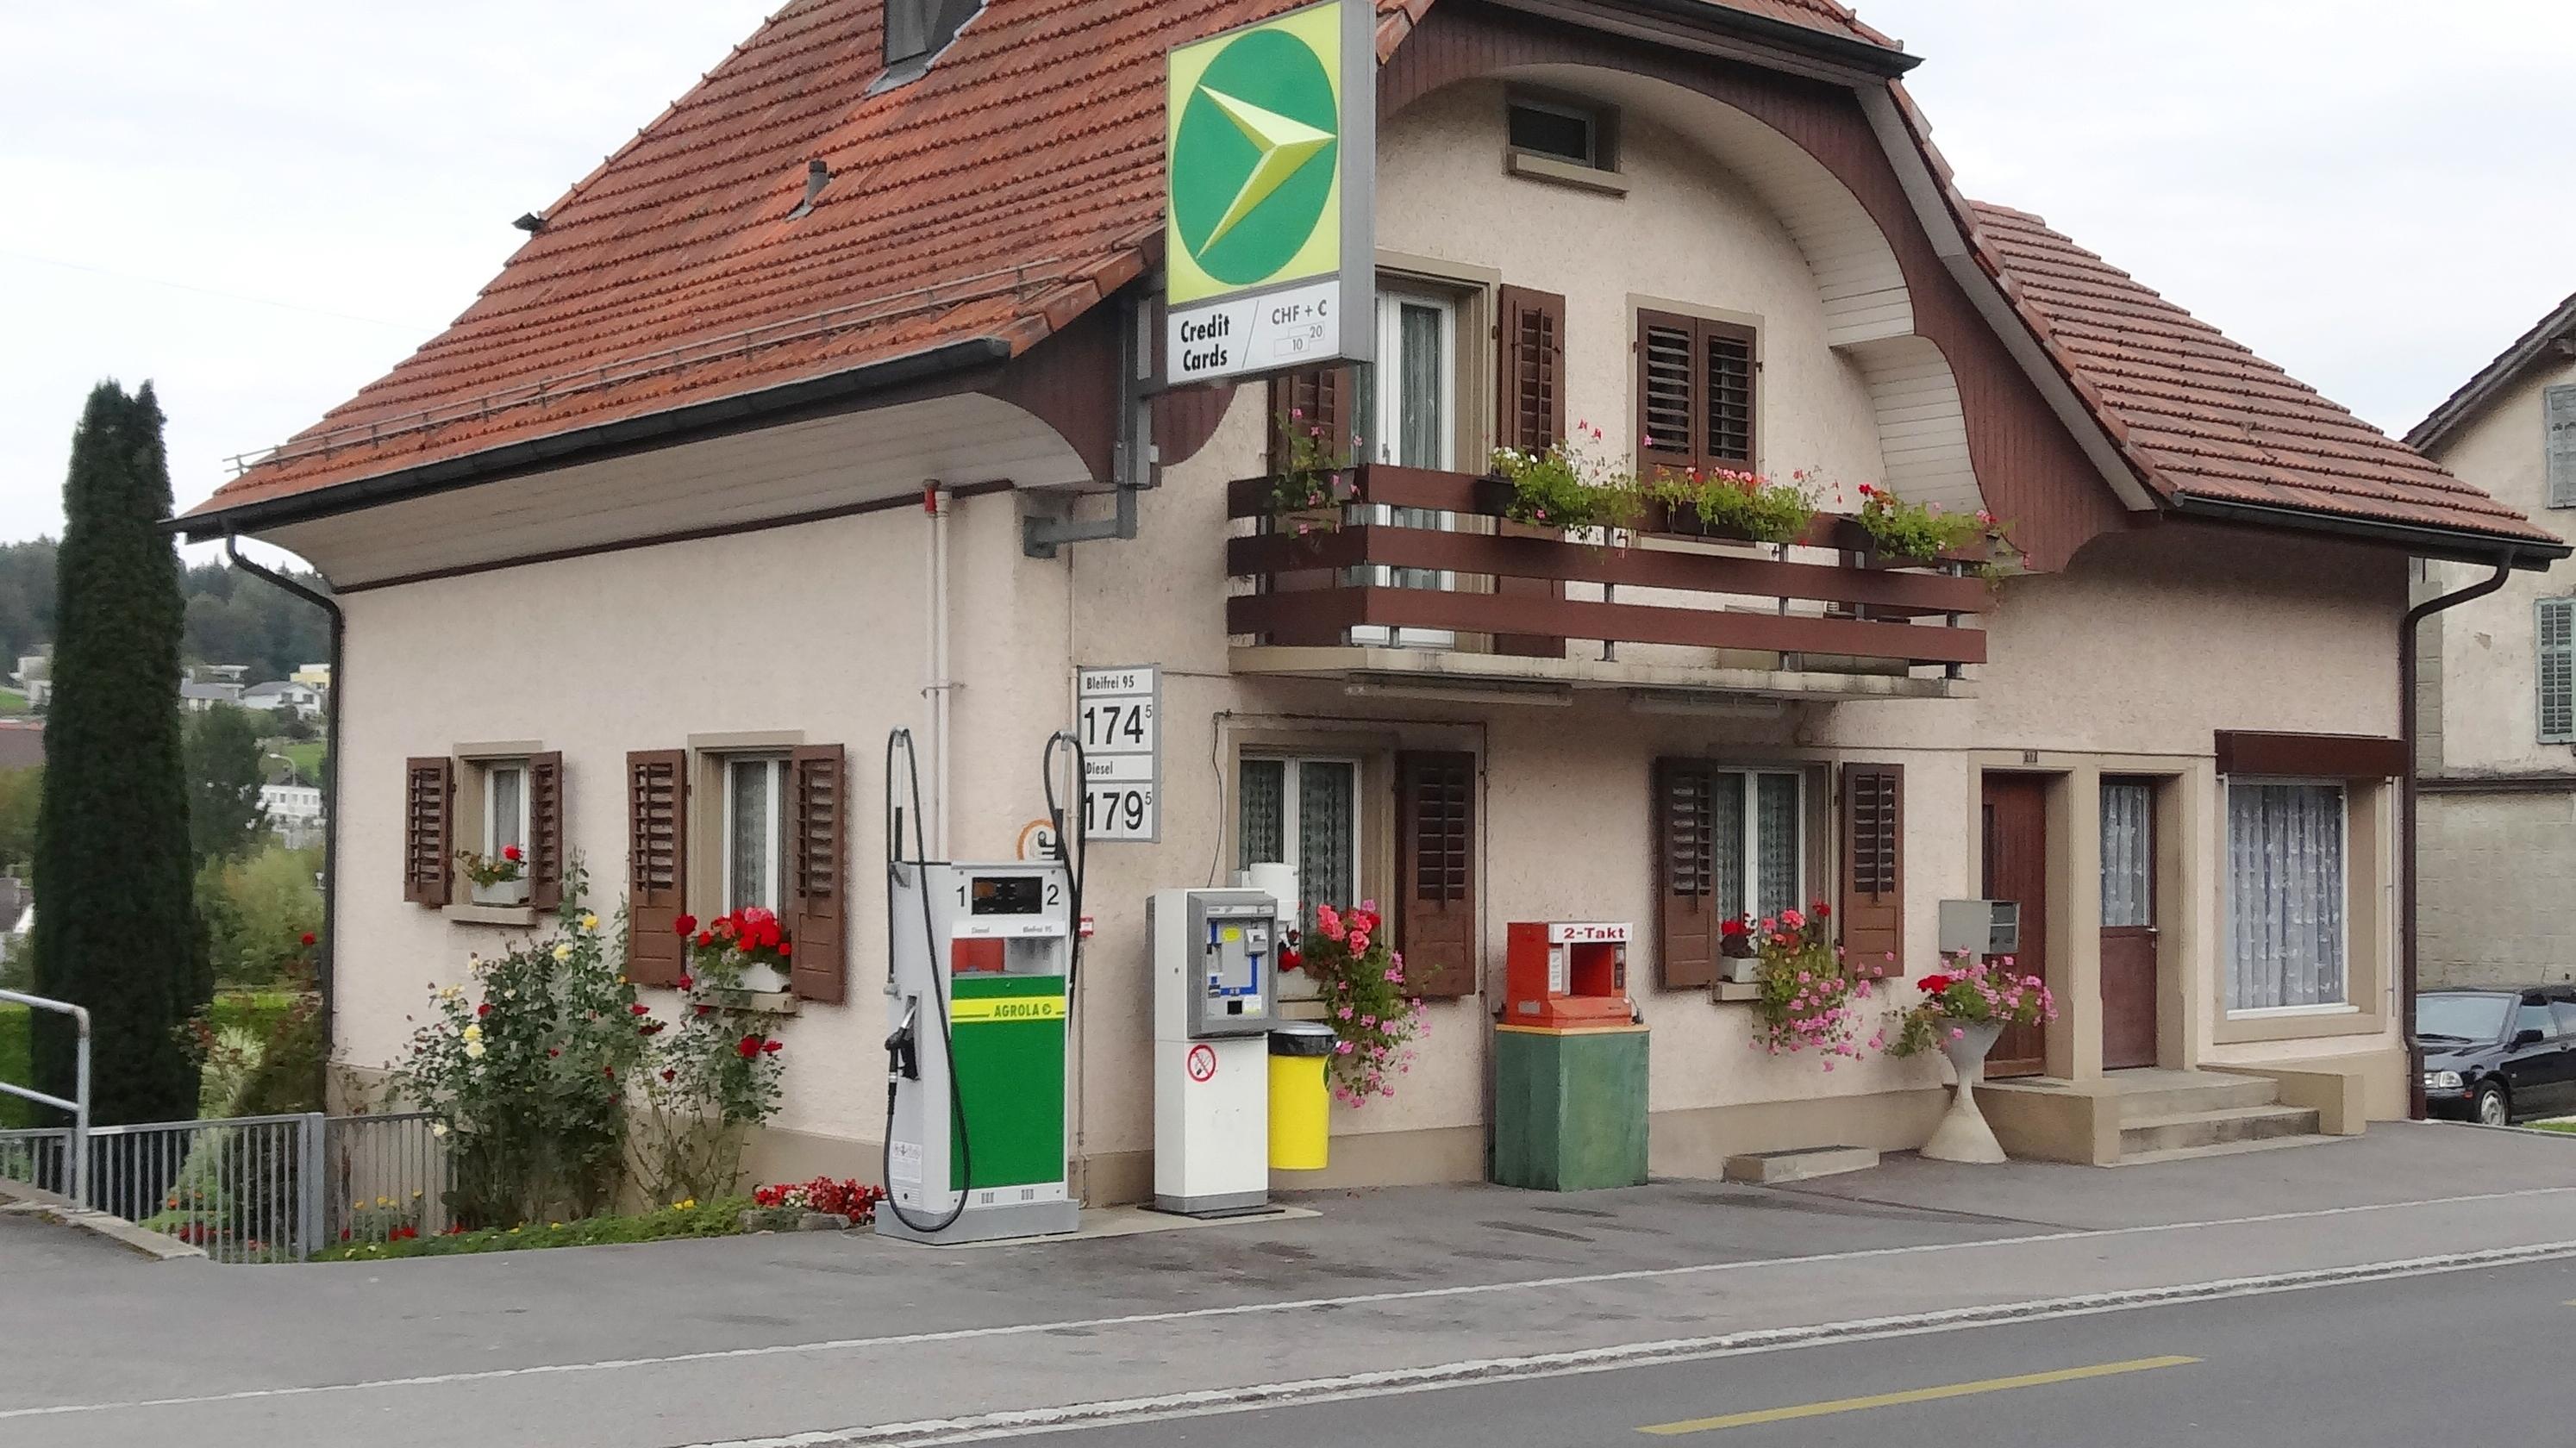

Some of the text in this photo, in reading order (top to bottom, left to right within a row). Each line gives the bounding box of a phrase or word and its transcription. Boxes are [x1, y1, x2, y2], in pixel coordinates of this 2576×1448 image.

[1272, 304, 1300, 325] CHF
[1180, 313, 1230, 343] Credit
[1310, 324, 1323, 339] 20
[1292, 338, 1304, 352] 10
[1183, 344, 1228, 371] Cards
[1086, 675, 1135, 690] Bleifrei 95
[1086, 760, 1113, 775] Diesel
[956, 885, 966, 907] 1
[1047, 884, 1060, 906] 2
[1564, 927, 1625, 939] 2-Takt
[994, 1003, 1040, 1017] AGROLA
